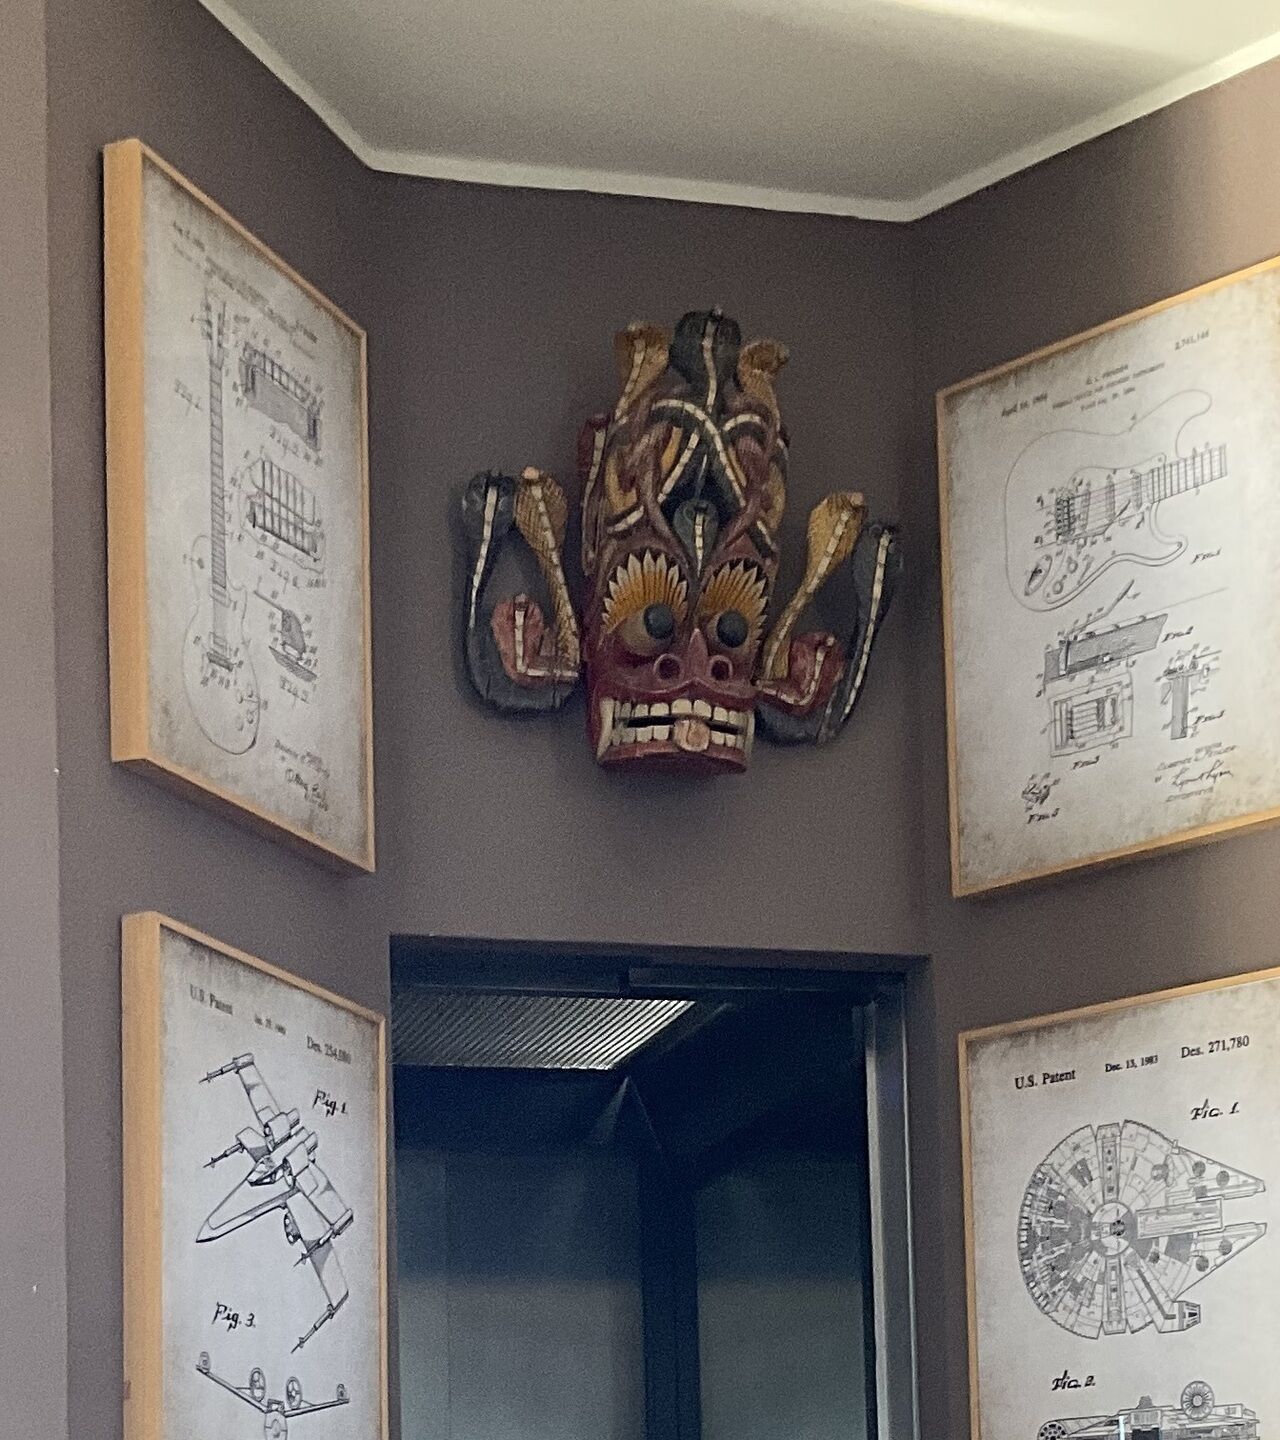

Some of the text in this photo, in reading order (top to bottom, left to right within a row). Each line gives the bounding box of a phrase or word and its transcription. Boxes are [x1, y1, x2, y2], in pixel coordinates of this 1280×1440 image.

[1014, 1076, 1039, 1091] U.S.
[1042, 1069, 1076, 1086] Patent
[1180, 1045, 1204, 1059] Des.
[1207, 1034, 1251, 1054] 271,780
